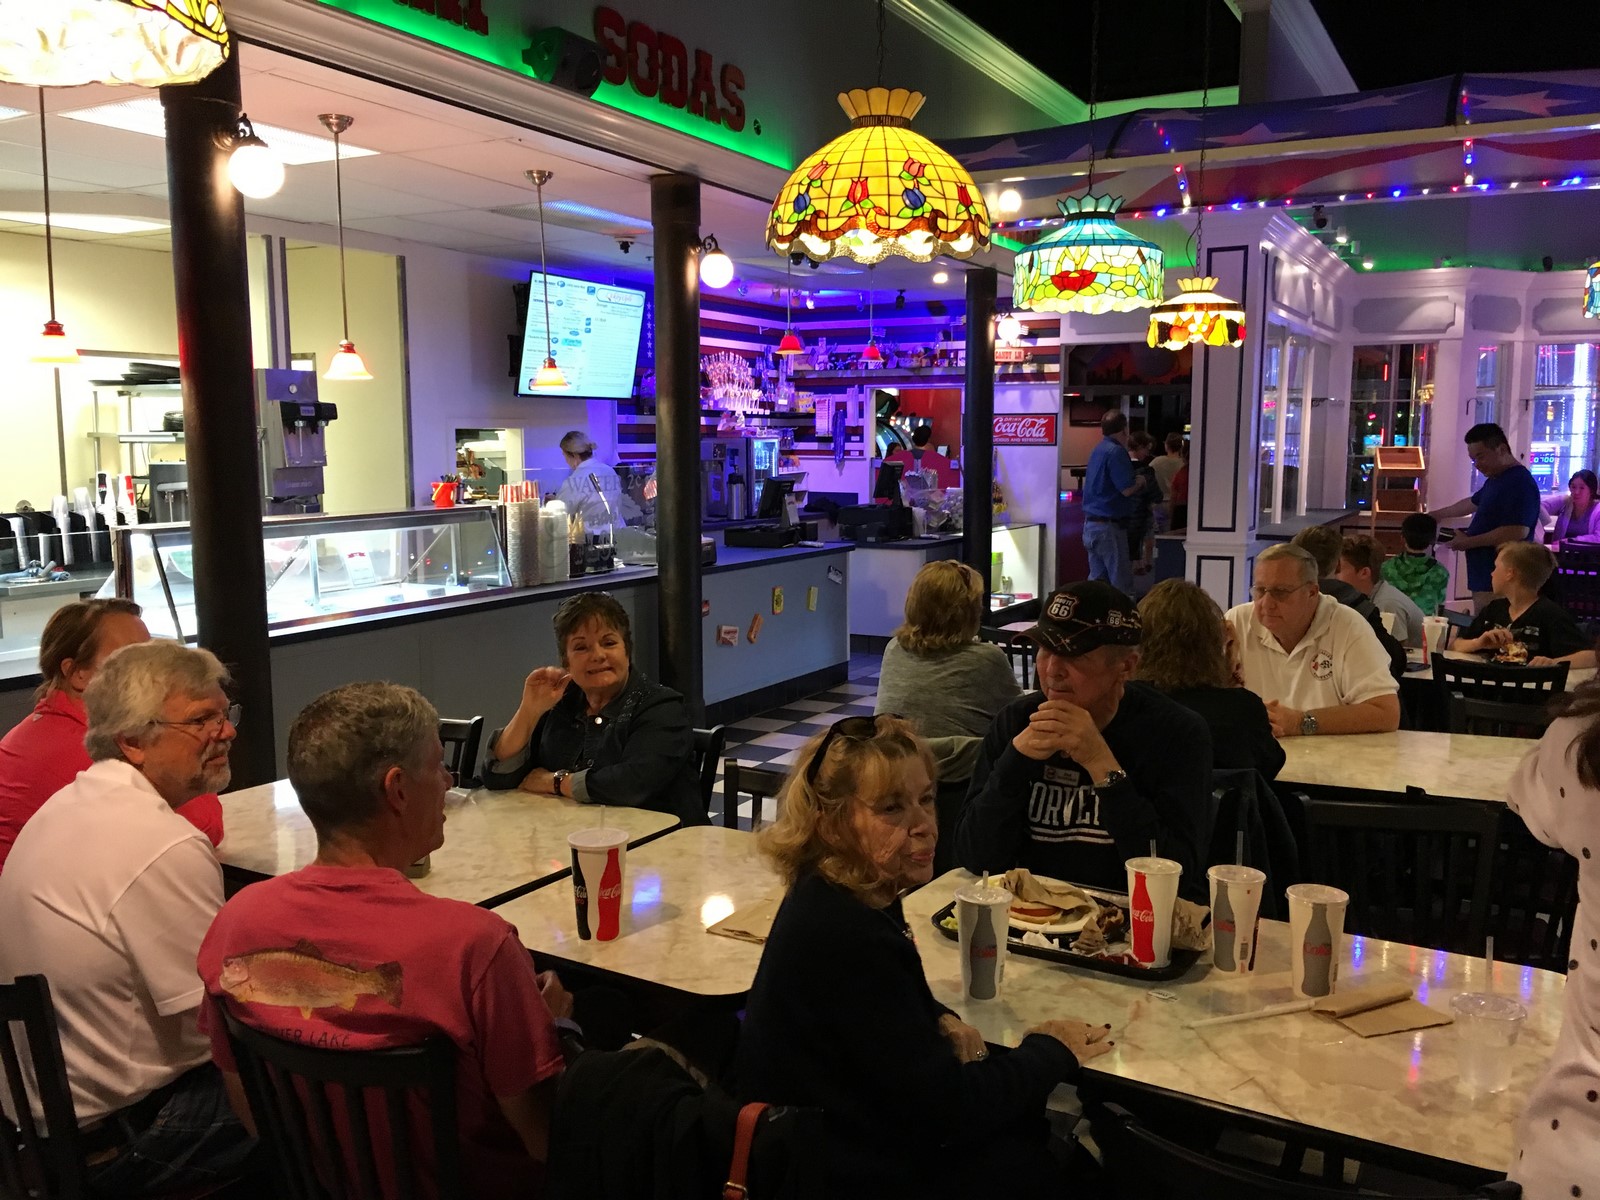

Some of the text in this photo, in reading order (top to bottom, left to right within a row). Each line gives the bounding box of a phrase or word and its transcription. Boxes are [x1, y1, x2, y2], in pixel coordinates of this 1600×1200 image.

[594, 5, 746, 132] SODAS
[1051, 603, 1070, 617] 66
[1109, 616, 1120, 625] 66
[1028, 781, 1100, 826] ORVE
